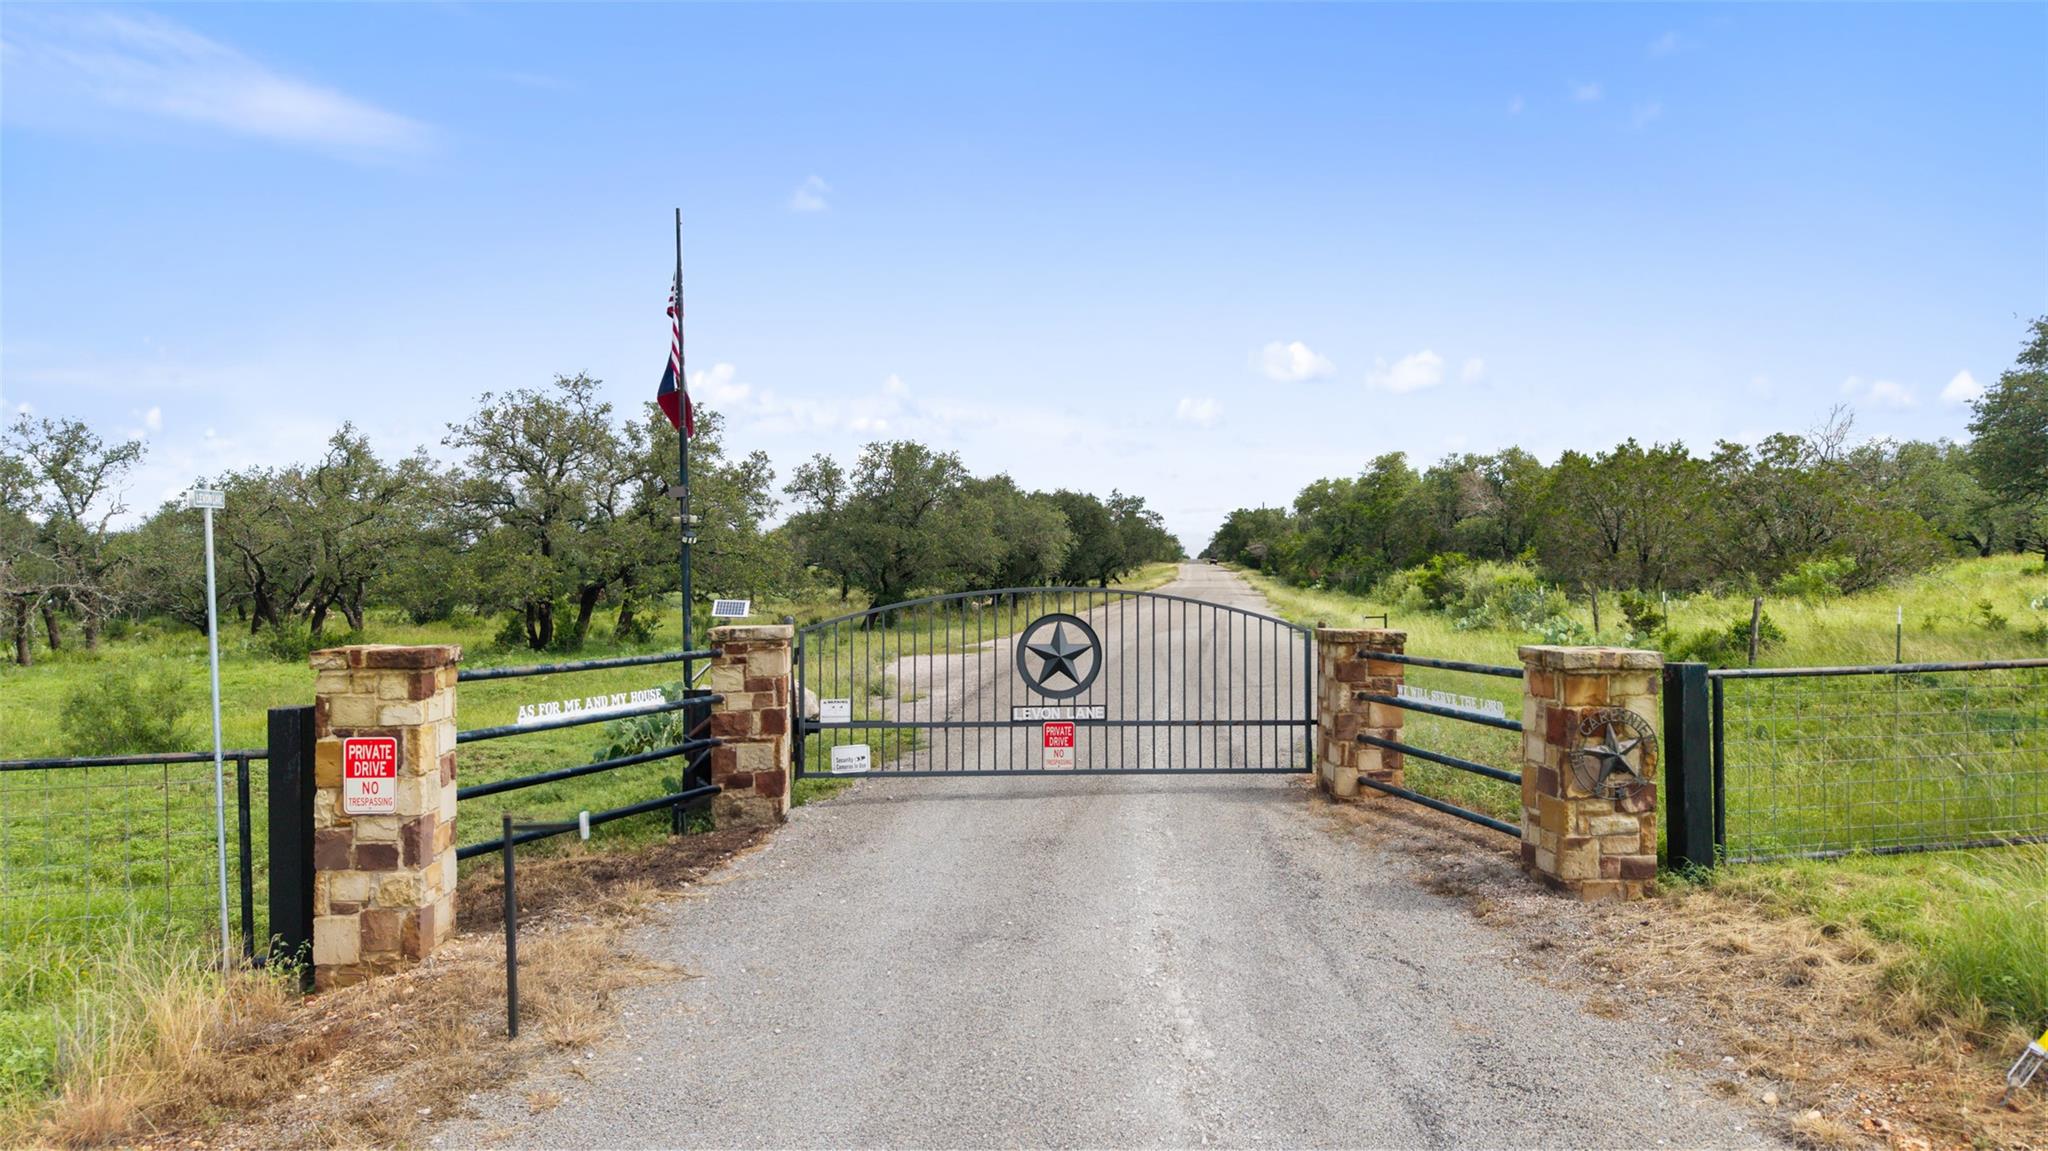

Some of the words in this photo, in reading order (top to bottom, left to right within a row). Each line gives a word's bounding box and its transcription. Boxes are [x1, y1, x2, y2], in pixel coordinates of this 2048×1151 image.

[519, 705, 535, 718] AS
[538, 701, 561, 716] FOR
[564, 698, 582, 711] ME
[585, 695, 608, 709] AND
[611, 692, 627, 706] MY
[1013, 707, 1060, 720] LEVON
[1067, 707, 1105, 719] LANE
[1046, 727, 1072, 736] PRIVATE
[1049, 737, 1069, 746] DRIVE
[349, 744, 392, 760] PRIVATE
[1053, 749, 1064, 758] NO
[354, 761, 387, 776] DRIVE
[362, 781, 379, 794] NO
[349, 797, 393, 807] TRESPASSING
